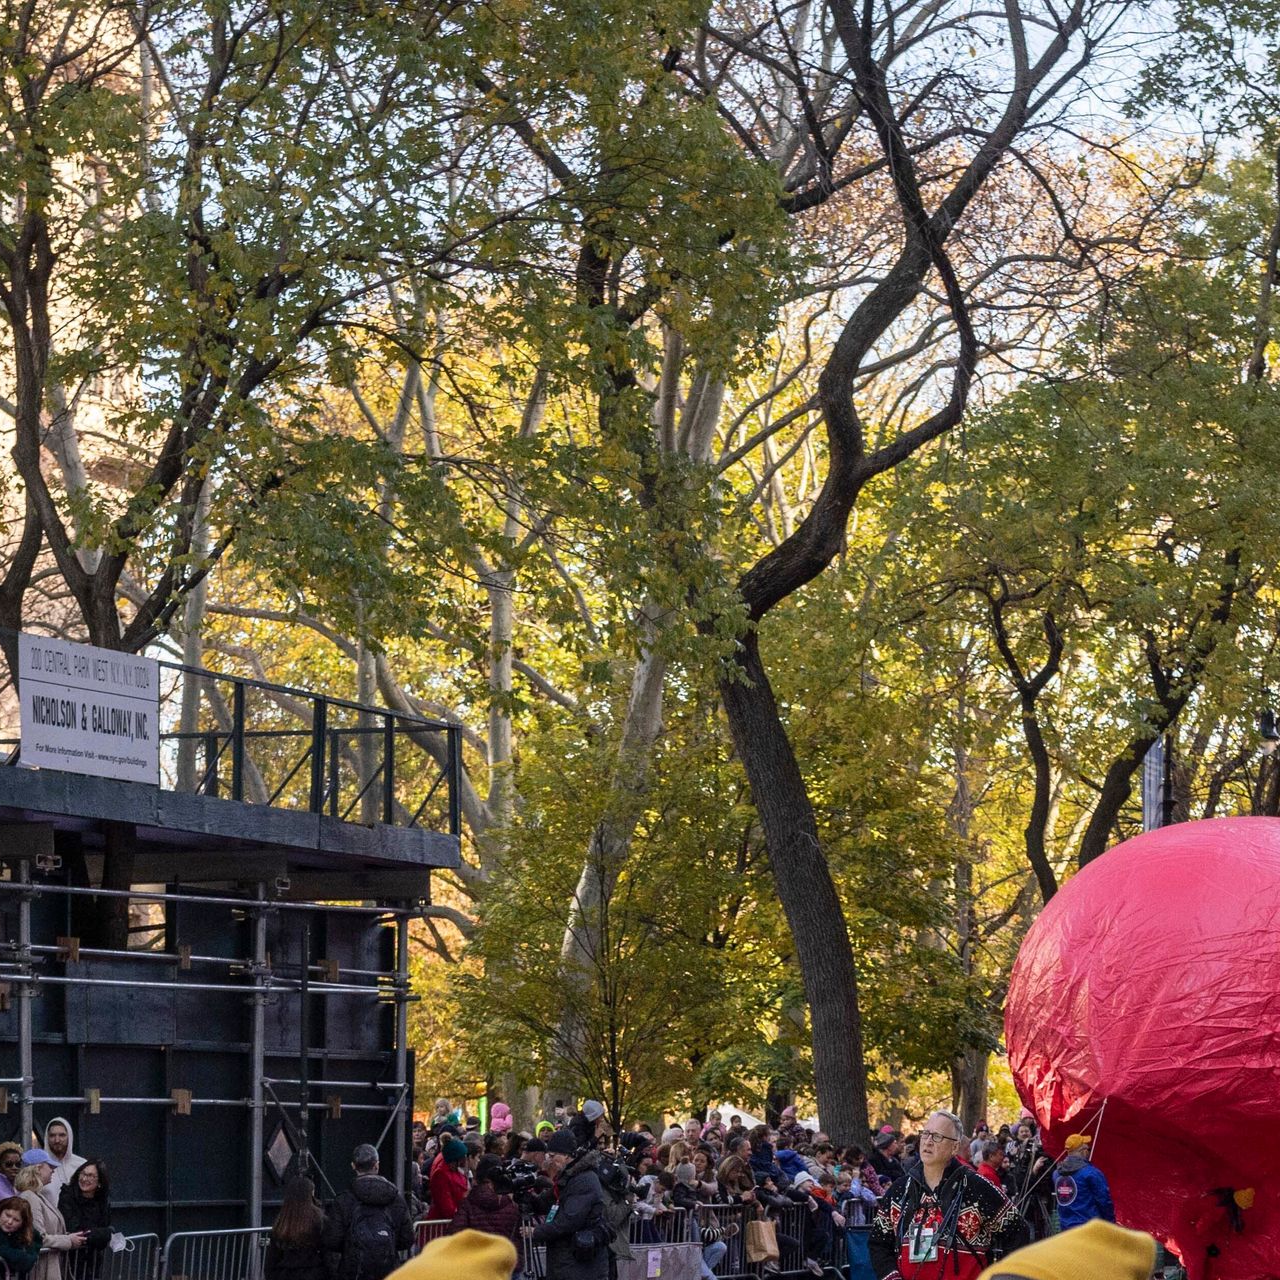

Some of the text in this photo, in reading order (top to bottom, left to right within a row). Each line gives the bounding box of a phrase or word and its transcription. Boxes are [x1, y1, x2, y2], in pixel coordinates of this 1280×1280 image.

[45, 650, 71, 676] CENTRAL
[74, 655, 90, 679] PARK
[92, 658, 108, 681] WEST
[32, 695, 150, 743] NICHOLSON & GALLOWAY, INC.
[36, 743, 44, 752] For
[45, 745, 57, 754] More
[57, 746, 84, 758] Information
